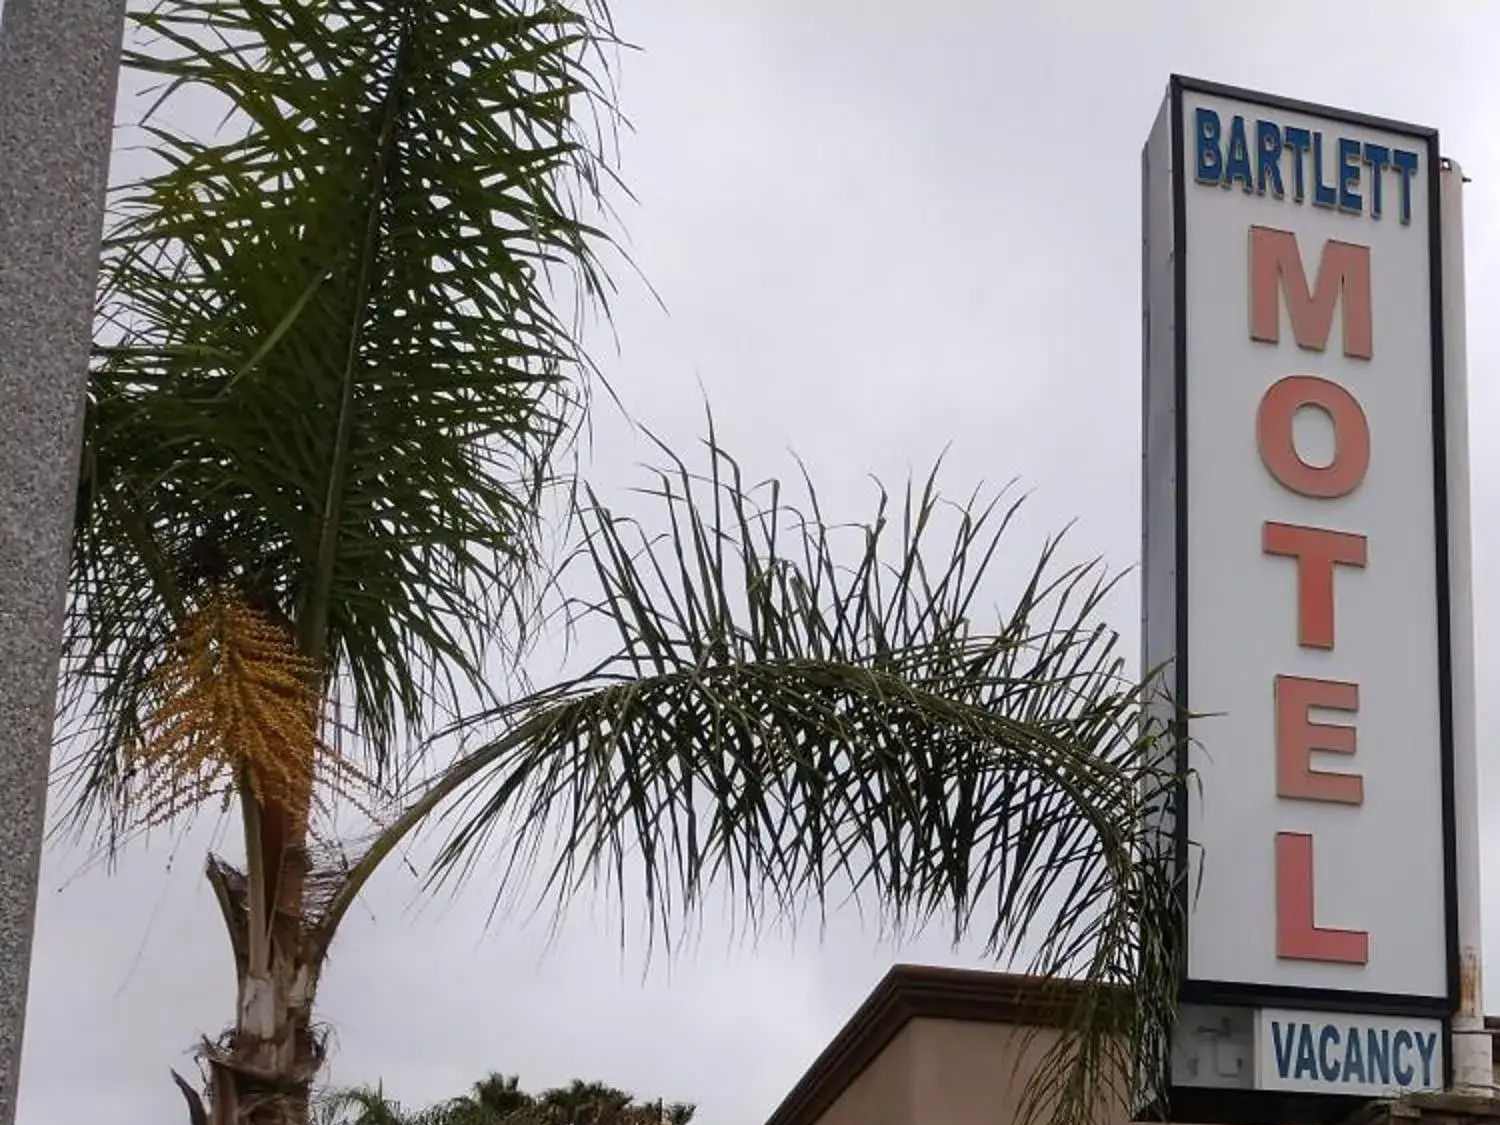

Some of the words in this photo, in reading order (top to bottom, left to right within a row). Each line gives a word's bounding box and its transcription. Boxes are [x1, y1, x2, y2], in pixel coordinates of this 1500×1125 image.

[1194, 107, 1419, 226] BARTLETT
[1247, 224, 1374, 966] MOTEL
[1271, 1020, 1438, 1088] VACANCY
